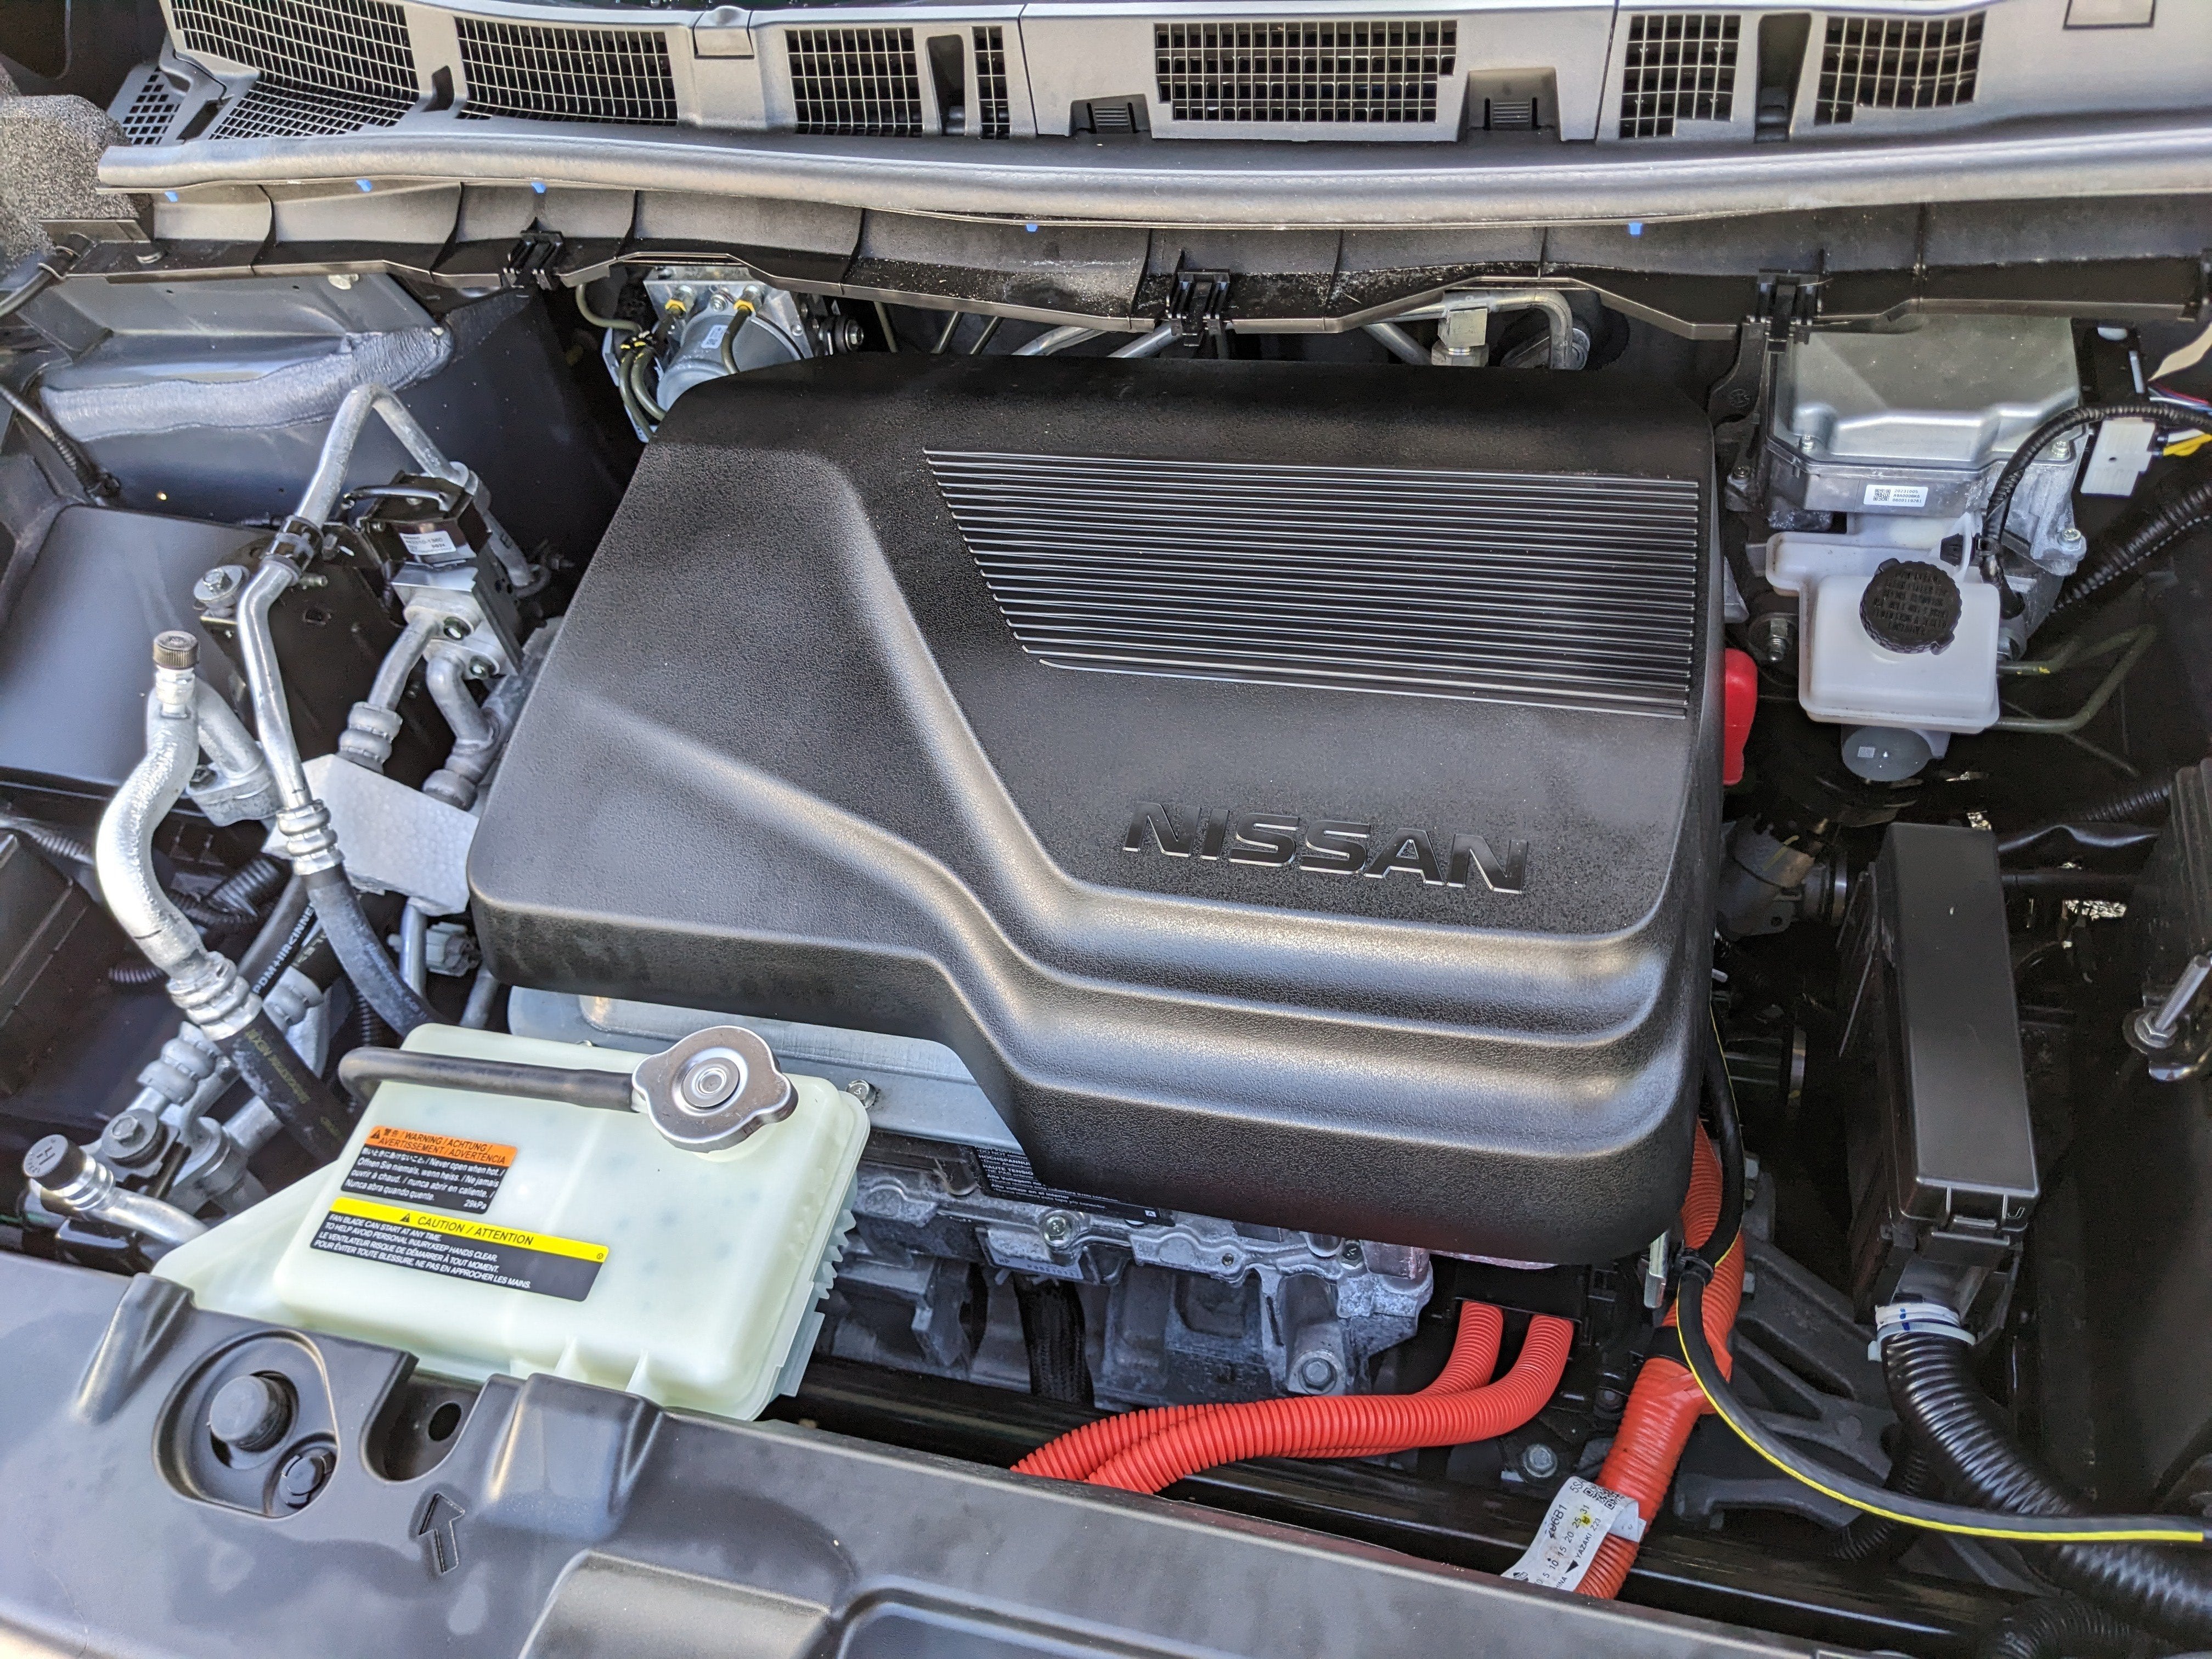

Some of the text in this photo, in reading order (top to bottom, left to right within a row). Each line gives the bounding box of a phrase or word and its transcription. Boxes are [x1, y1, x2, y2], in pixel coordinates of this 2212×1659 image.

[1123, 802, 1528, 894] NISSAN
[378, 1137, 444, 1153] AVERTISSEMENT
[405, 1132, 443, 1144] WARNING
[447, 1139, 487, 1151] ACHTUNG
[351, 1169, 373, 1178] ouvrir
[407, 1179, 430, 1187] nunca
[430, 1182, 448, 1190] abrir
[379, 1161, 393, 1169] Sie
[420, 1170, 441, 1178] wenn
[474, 1177, 500, 1188] jamais
[428, 1158, 451, 1167] Never
[449, 1163, 467, 1171] open
[467, 1165, 487, 1173] when
[486, 1167, 500, 1176] hot.
[1007, 1167, 1034, 1176] TENSIO
[344, 1179, 368, 1189] Nunca
[366, 1182, 384, 1192] abra
[382, 1186, 410, 1197] quando
[342, 1216, 365, 1226] BLADE
[363, 1221, 381, 1229] CAN
[379, 1224, 402, 1233] START
[409, 1229, 426, 1238] ANY
[416, 1216, 465, 1232] CAUTION
[474, 1227, 533, 1245] ATTENTION
[327, 1233, 371, 1246] VENTILATEUR
[369, 1241, 396, 1251] RISQUE
[404, 1246, 445, 1261] DÉMARRER
[448, 1257, 469, 1266] TOUT
[333, 1224, 353, 1233] HELP
[351, 1227, 374, 1237] AVOID
[372, 1232, 409, 1244] PERSONAL
[448, 1246, 474, 1257] HANDS
[313, 1239, 335, 1249] POUR
[333, 1242, 358, 1253] ÉVITER
[356, 1248, 379, 1257] TOUTE
[425, 1262, 441, 1270] PAS
[449, 1267, 494, 1280] APPROCHER
[493, 1275, 508, 1283] LES
[1550, 1560, 1559, 1570] 10
[1558, 1547, 1566, 1556] 15
[1565, 1531, 1574, 1543] 20
[1572, 1517, 1582, 1528] 25
[1581, 1504, 1590, 1514] 31
[1575, 1533, 1592, 1559] YAZAKI
